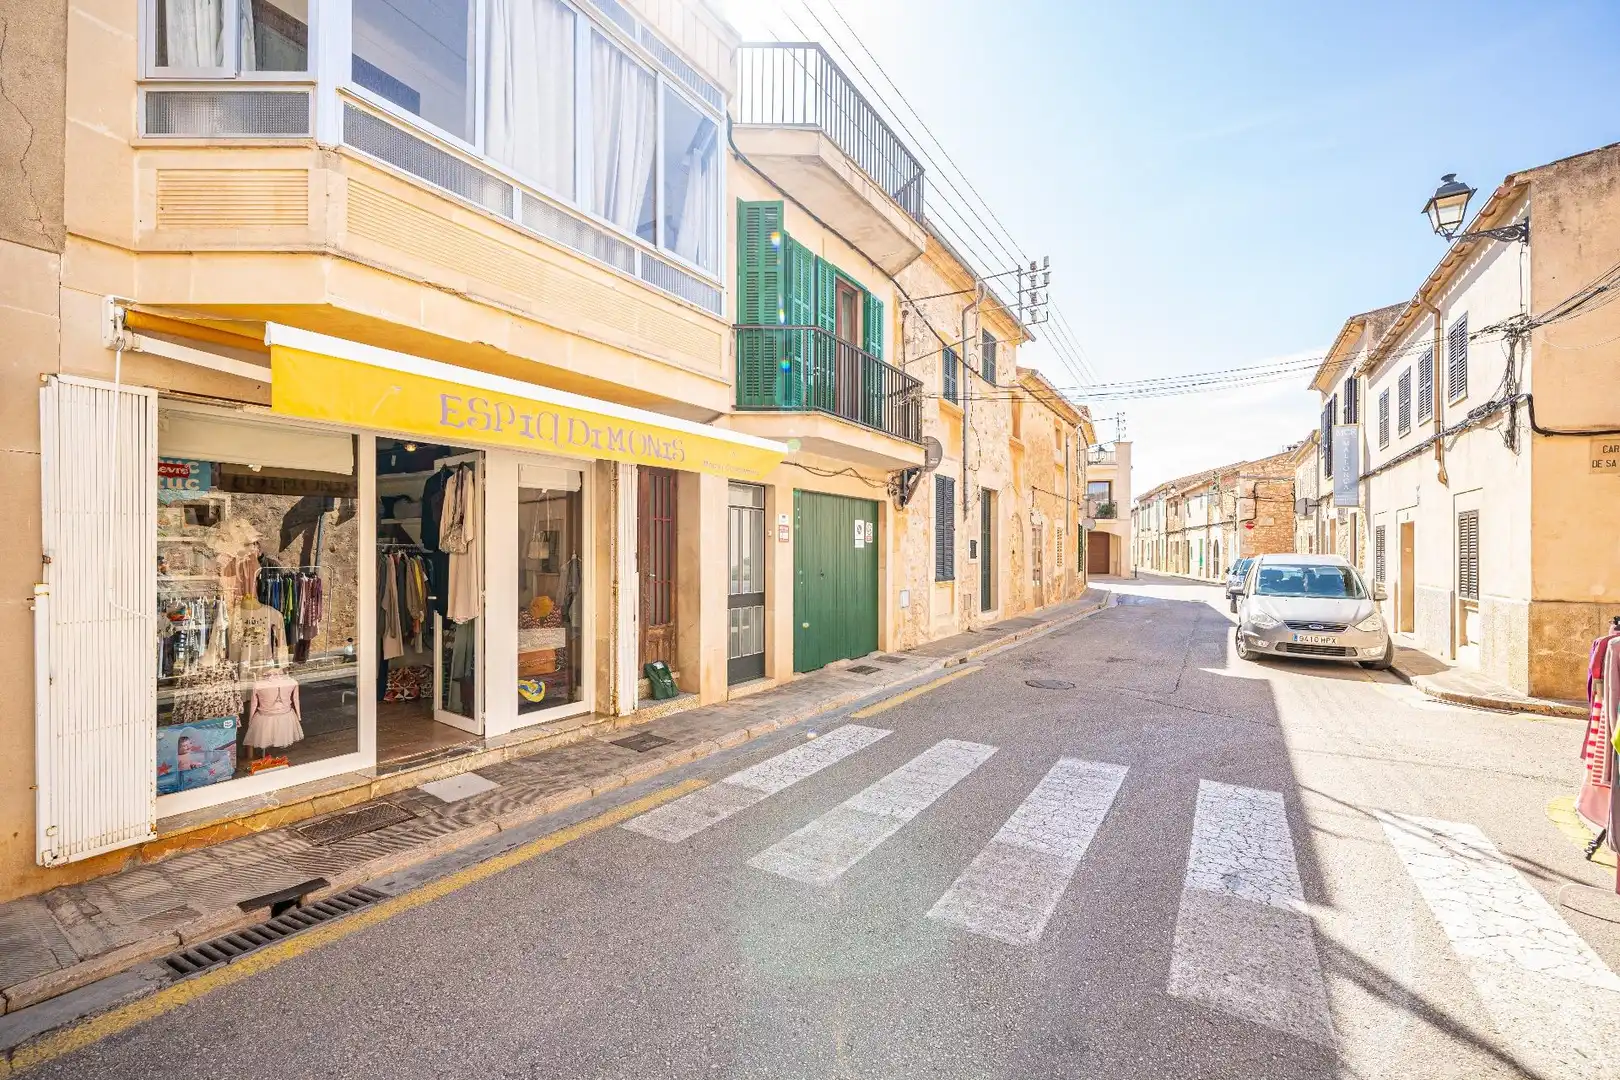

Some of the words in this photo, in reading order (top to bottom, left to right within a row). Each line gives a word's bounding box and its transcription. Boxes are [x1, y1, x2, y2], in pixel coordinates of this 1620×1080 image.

[1592, 459, 1603, 468] DE
[1606, 459, 1617, 468] SA
[1320, 637, 1337, 645] HPX
